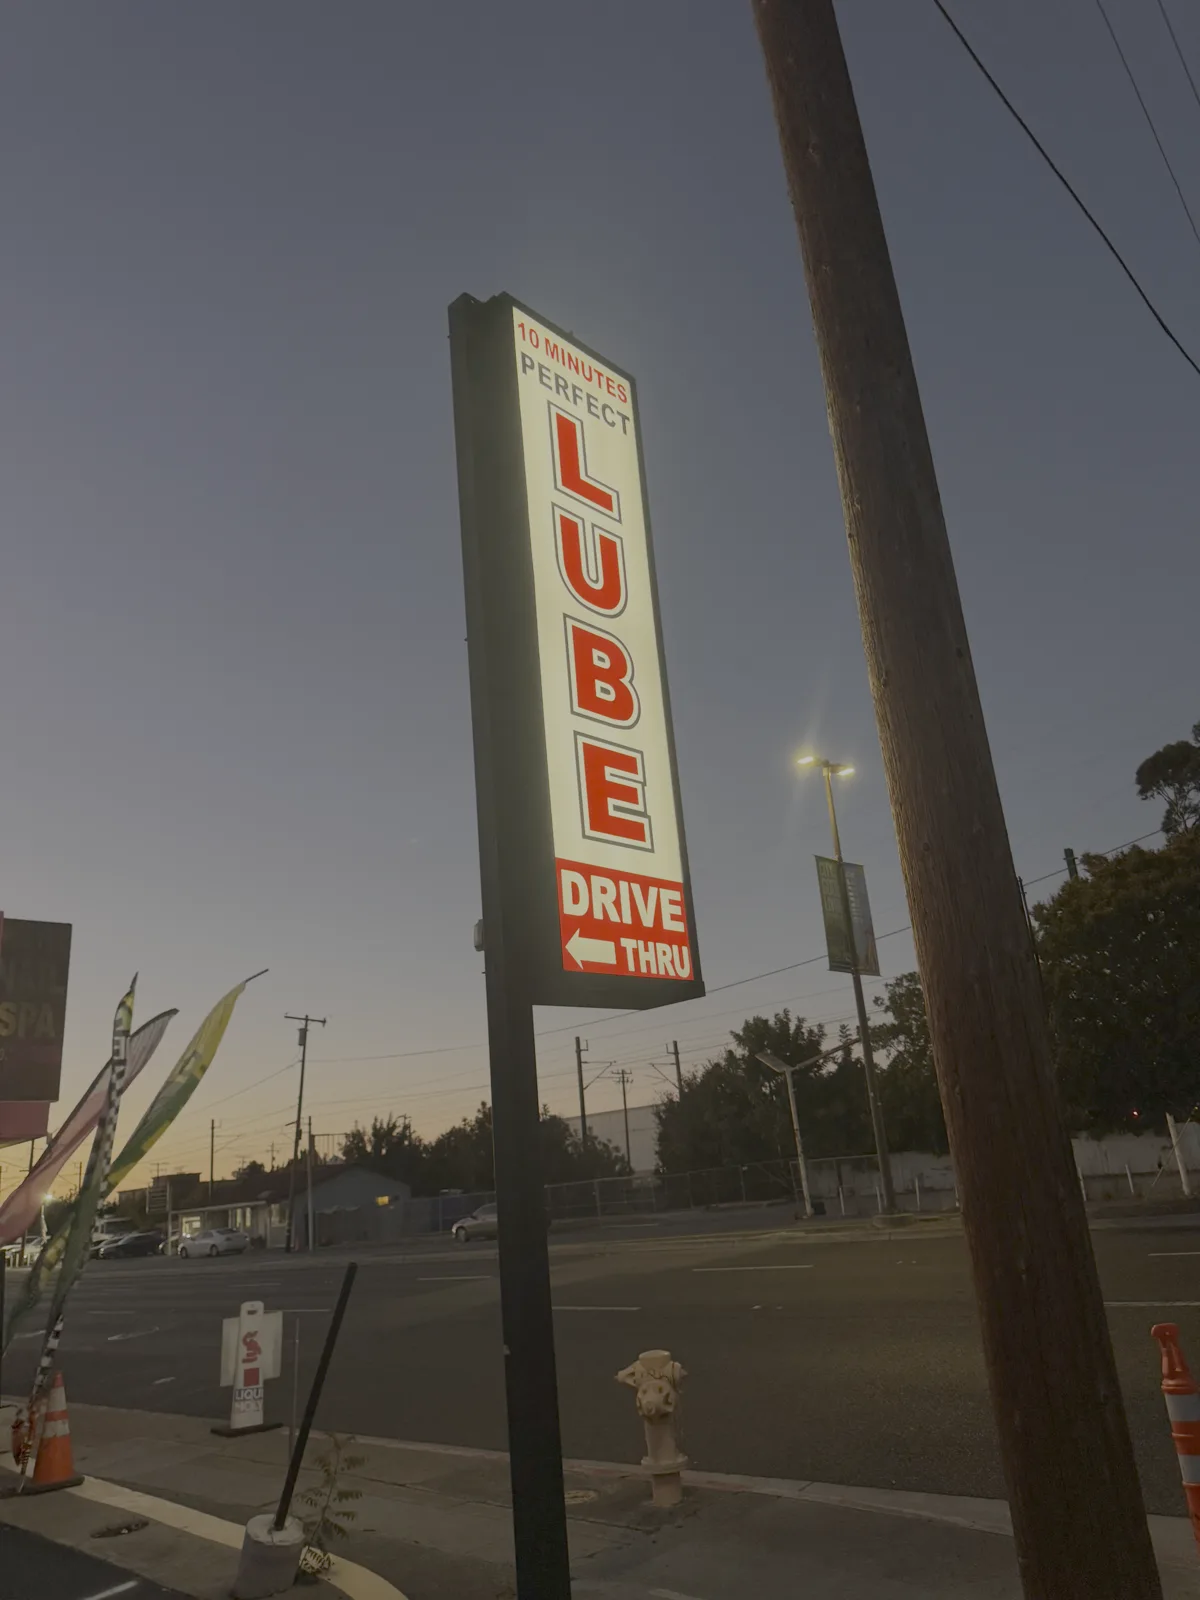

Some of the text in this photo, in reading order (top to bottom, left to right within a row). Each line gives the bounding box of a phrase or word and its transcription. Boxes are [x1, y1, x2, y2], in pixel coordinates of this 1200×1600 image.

[518, 322, 628, 404] 10 MINUTES
[520, 351, 630, 436] PERFECT
[548, 400, 655, 853] LUBE
[560, 868, 686, 933] DRIVE
[620, 937, 691, 979] THRU
[0, 1001, 56, 1039] SPA
